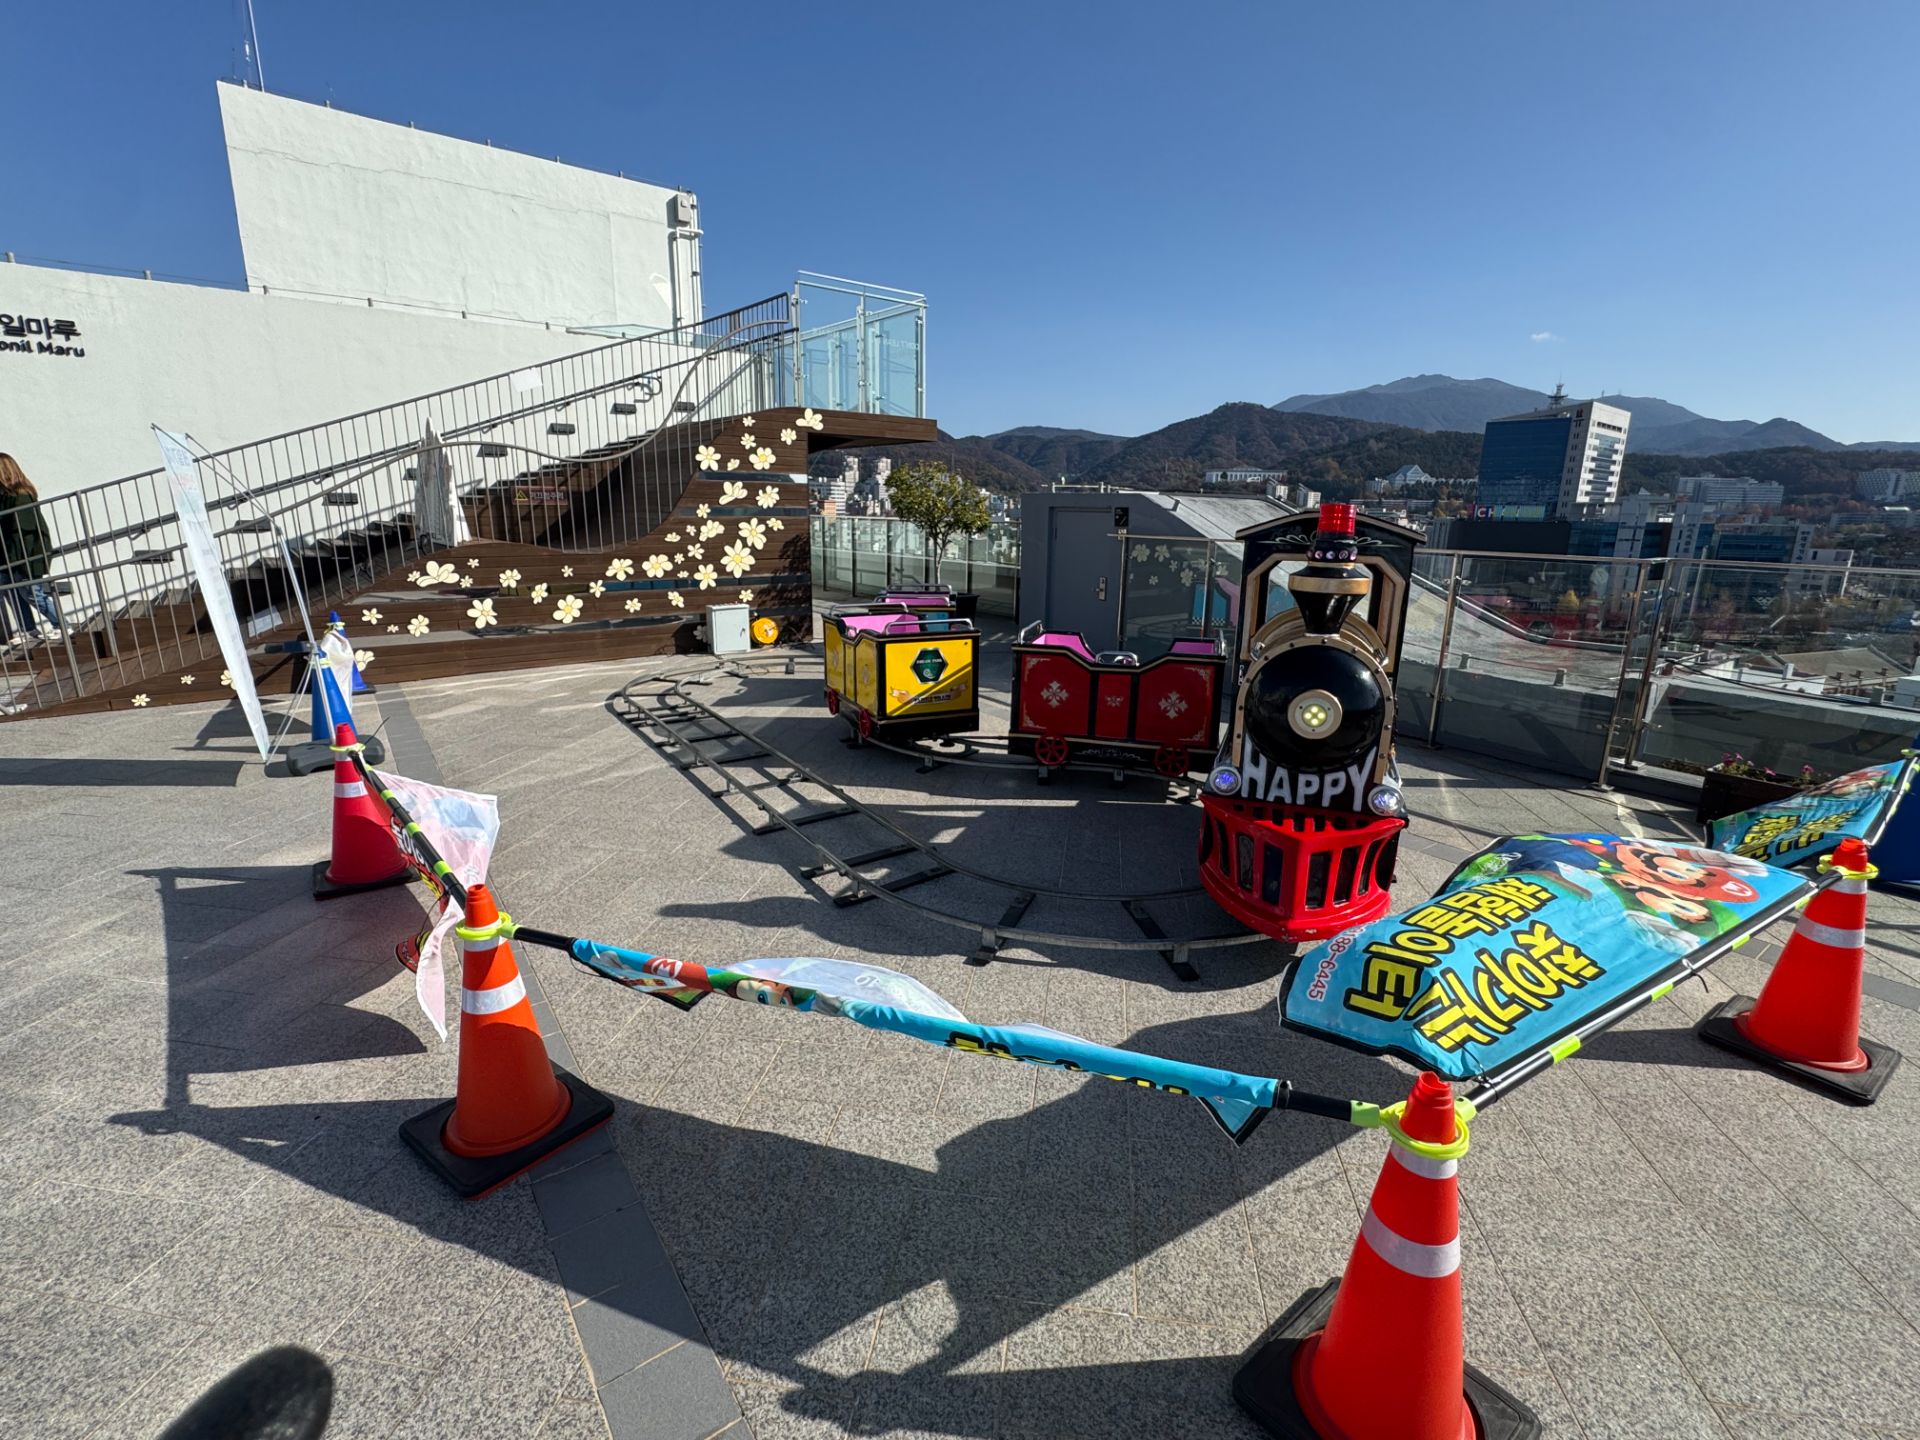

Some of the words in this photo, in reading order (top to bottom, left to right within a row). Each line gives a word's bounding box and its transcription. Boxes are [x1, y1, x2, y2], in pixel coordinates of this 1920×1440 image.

[37, 341, 86, 358] Maru
[1240, 734, 1377, 812] HAPPY
[1343, 876, 1558, 1021] 체험놀이터
[1403, 919, 1606, 1050] 찾아가는
